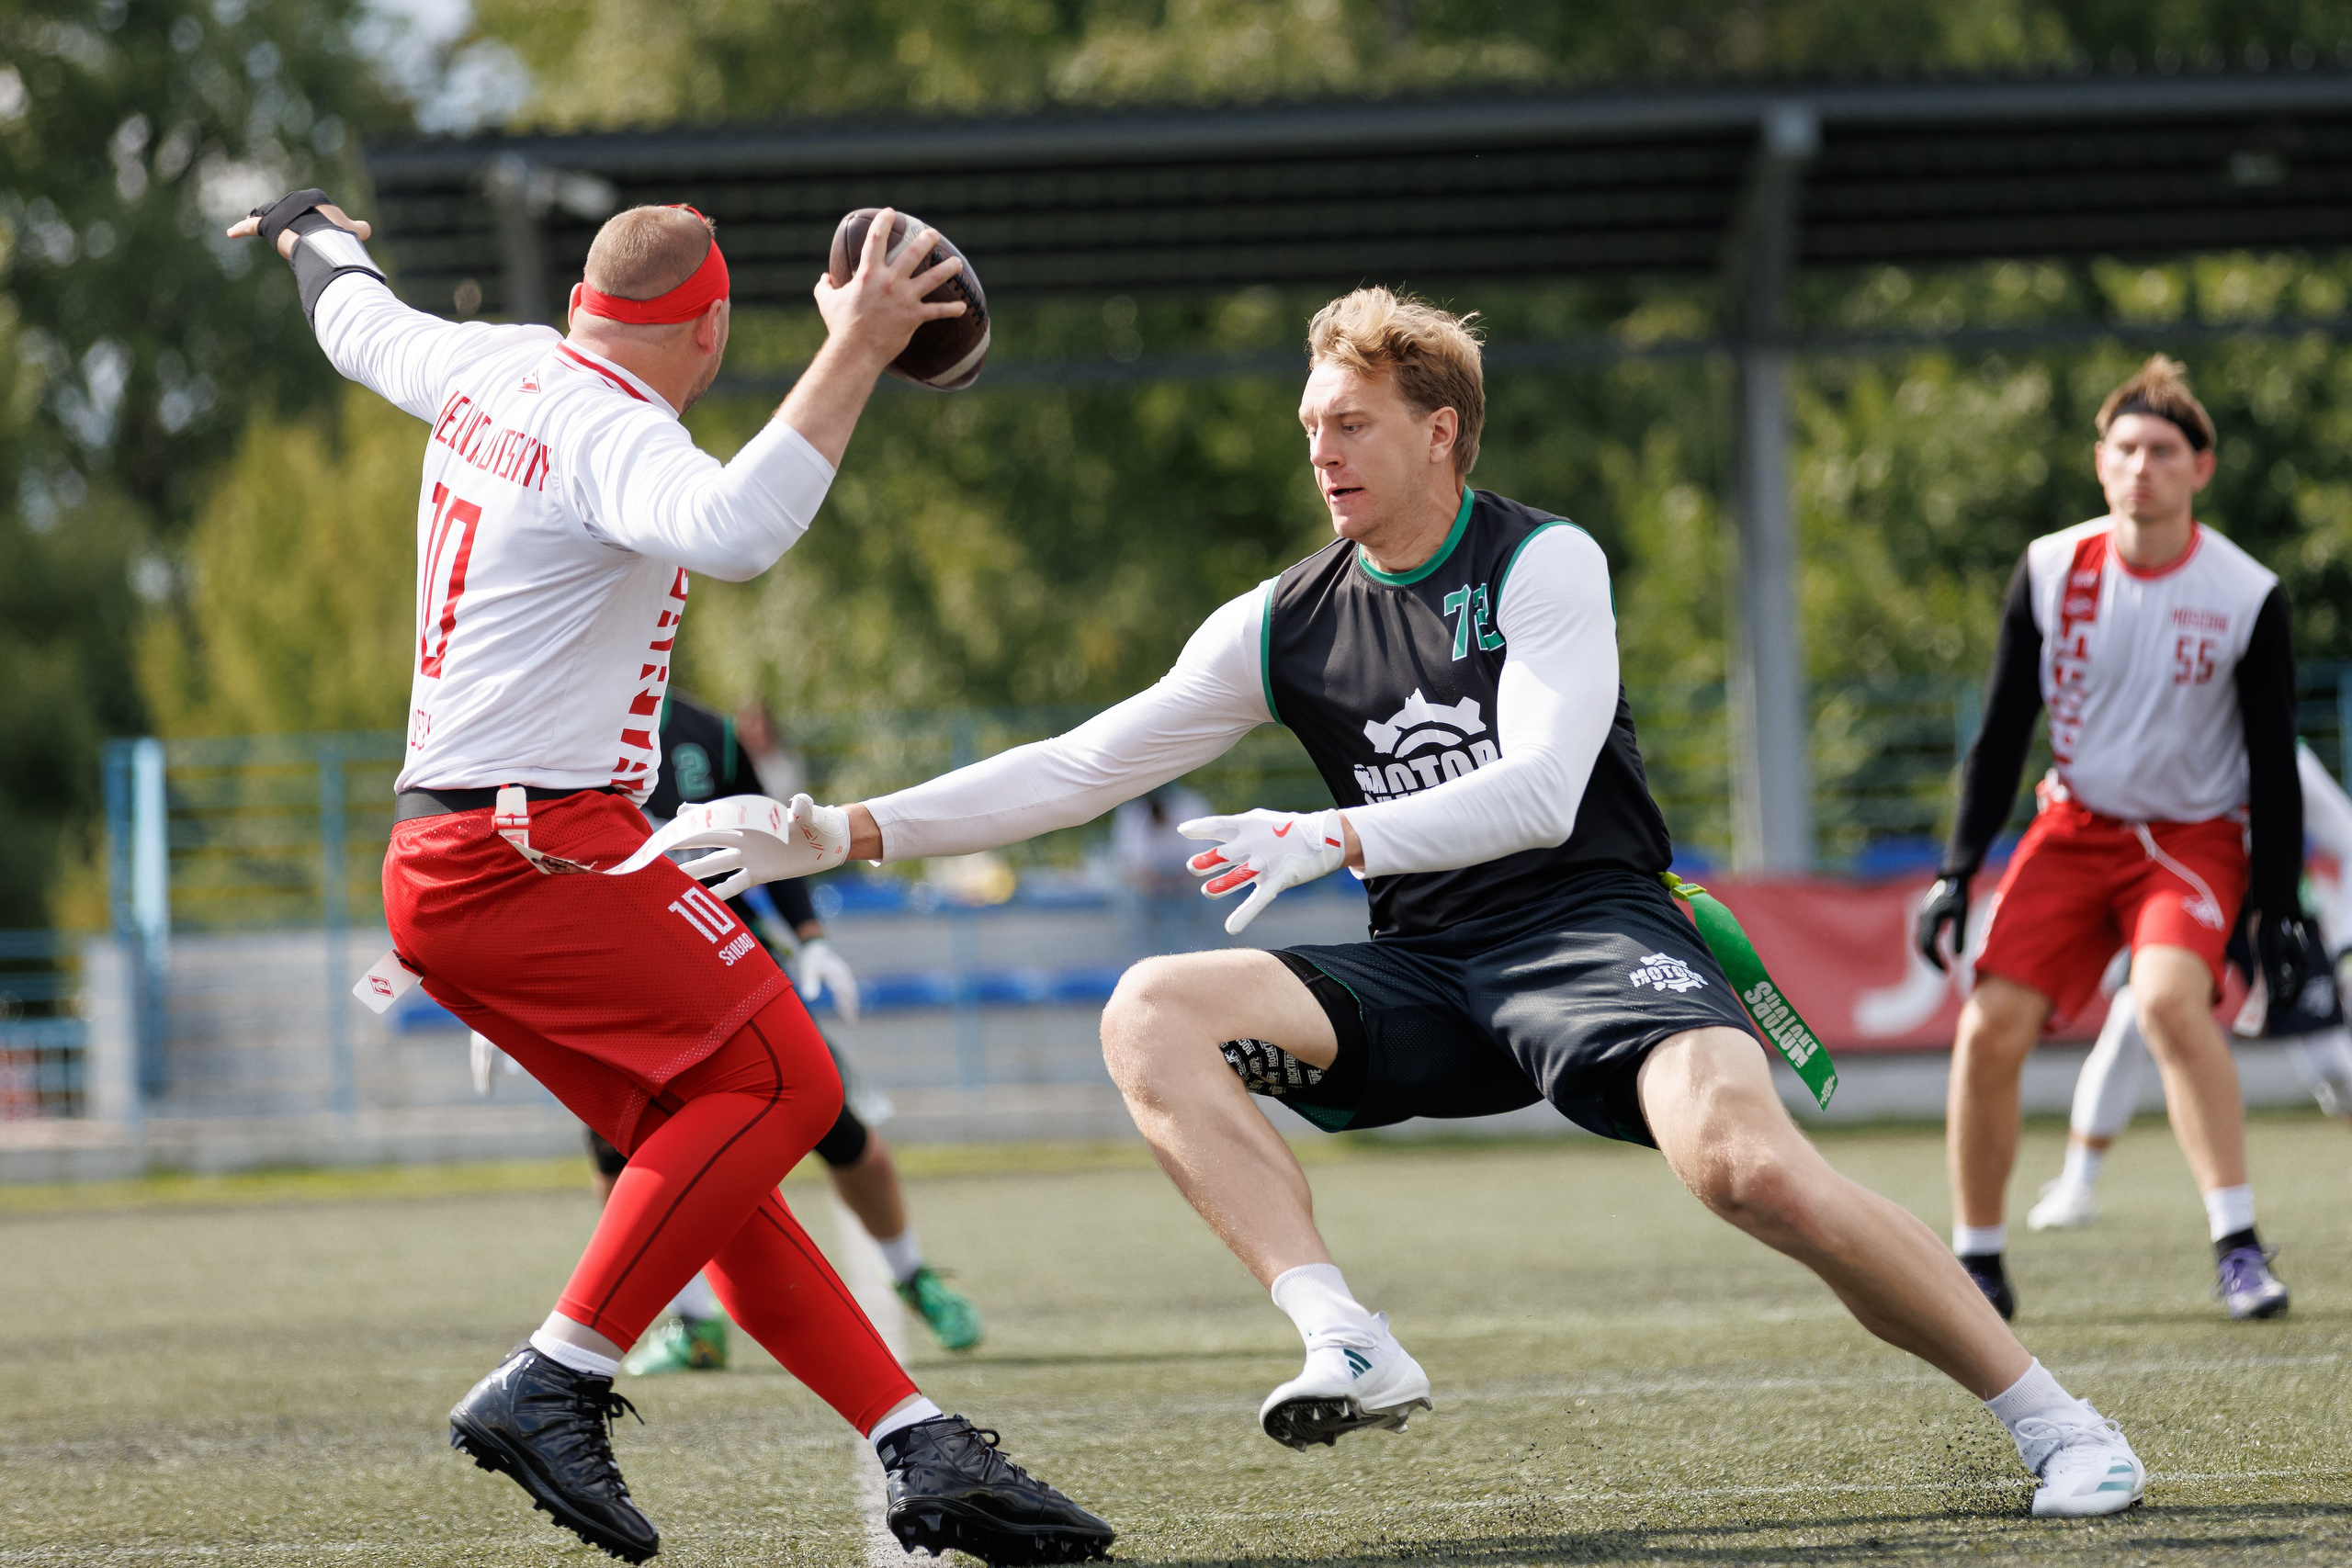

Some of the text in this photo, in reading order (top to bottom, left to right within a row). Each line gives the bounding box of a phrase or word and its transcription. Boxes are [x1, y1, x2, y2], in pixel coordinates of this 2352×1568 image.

[421, 481, 482, 679] 10
[1443, 582, 1505, 661] 72
[2173, 635, 2218, 685] 55
[667, 886, 736, 944] 10
